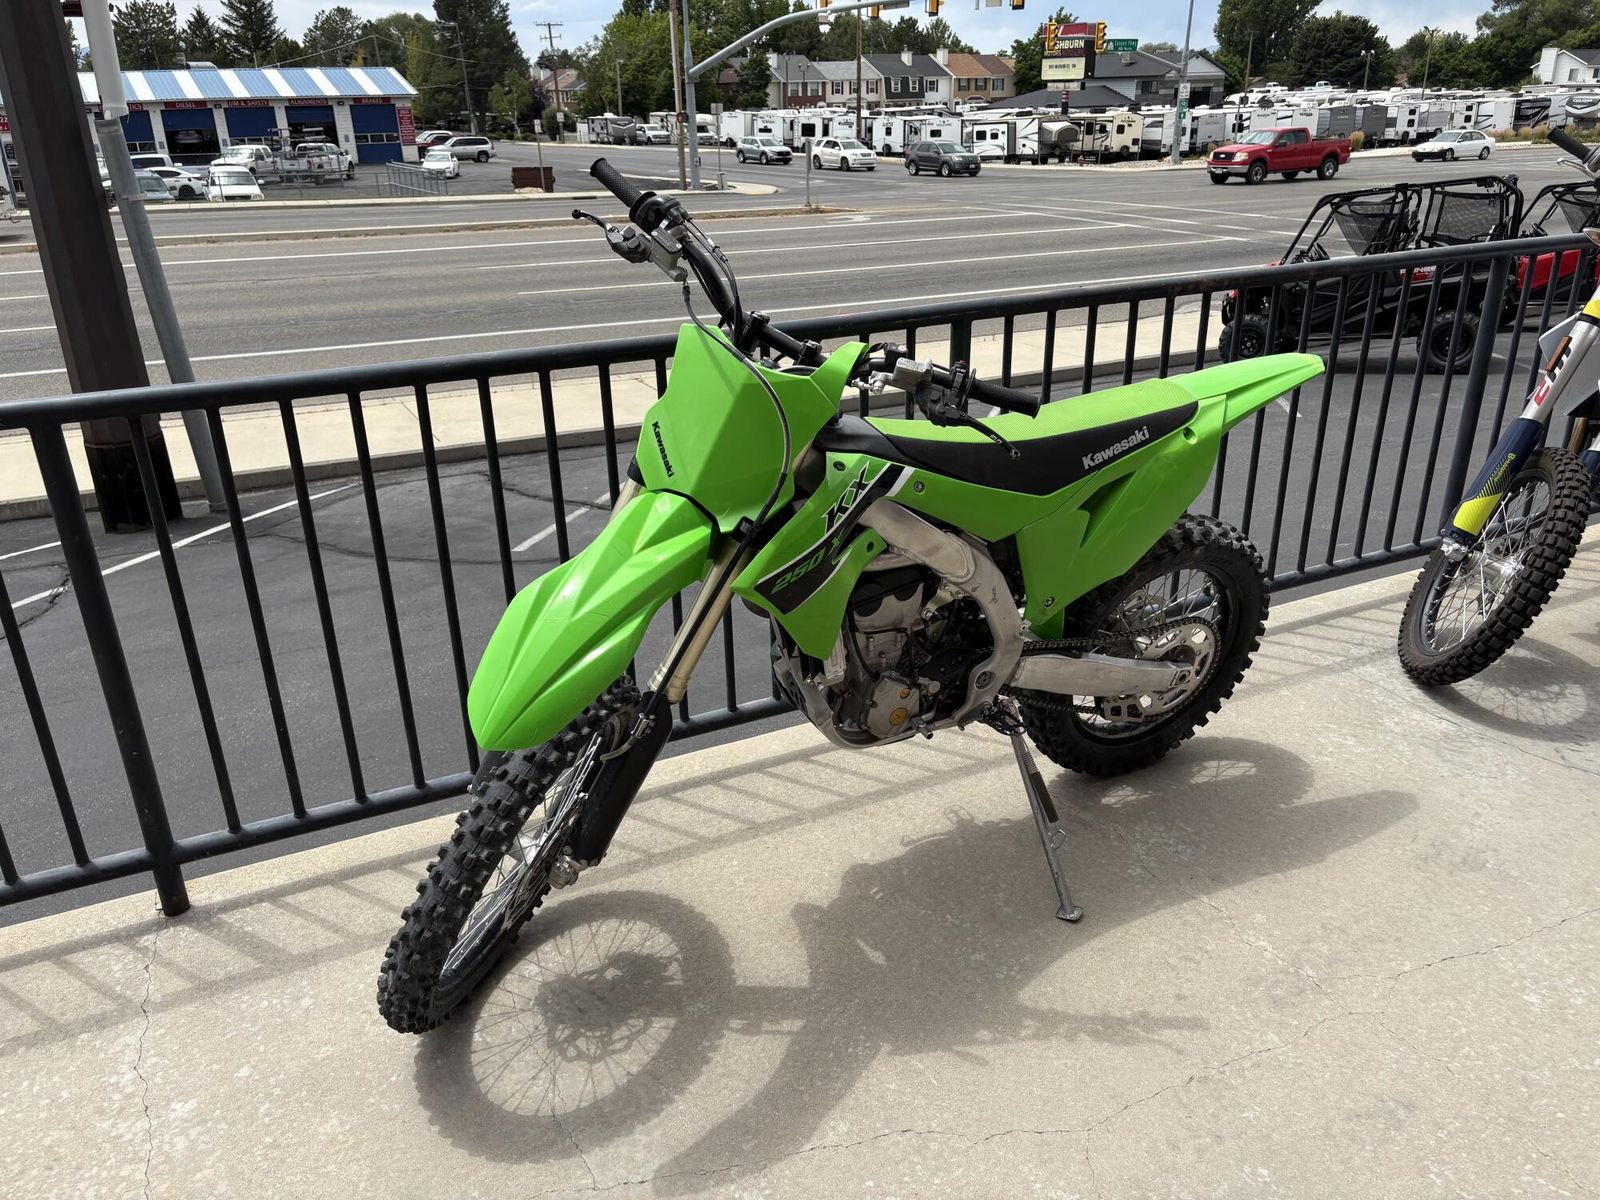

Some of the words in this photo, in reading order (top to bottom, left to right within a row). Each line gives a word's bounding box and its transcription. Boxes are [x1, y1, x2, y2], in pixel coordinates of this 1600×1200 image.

[1045, 39, 1085, 51] SHBURN
[652, 421, 675, 478] Kawasaki
[1081, 425, 1150, 470] Kawasaki
[821, 459, 874, 536] KX
[770, 546, 827, 595] 250
